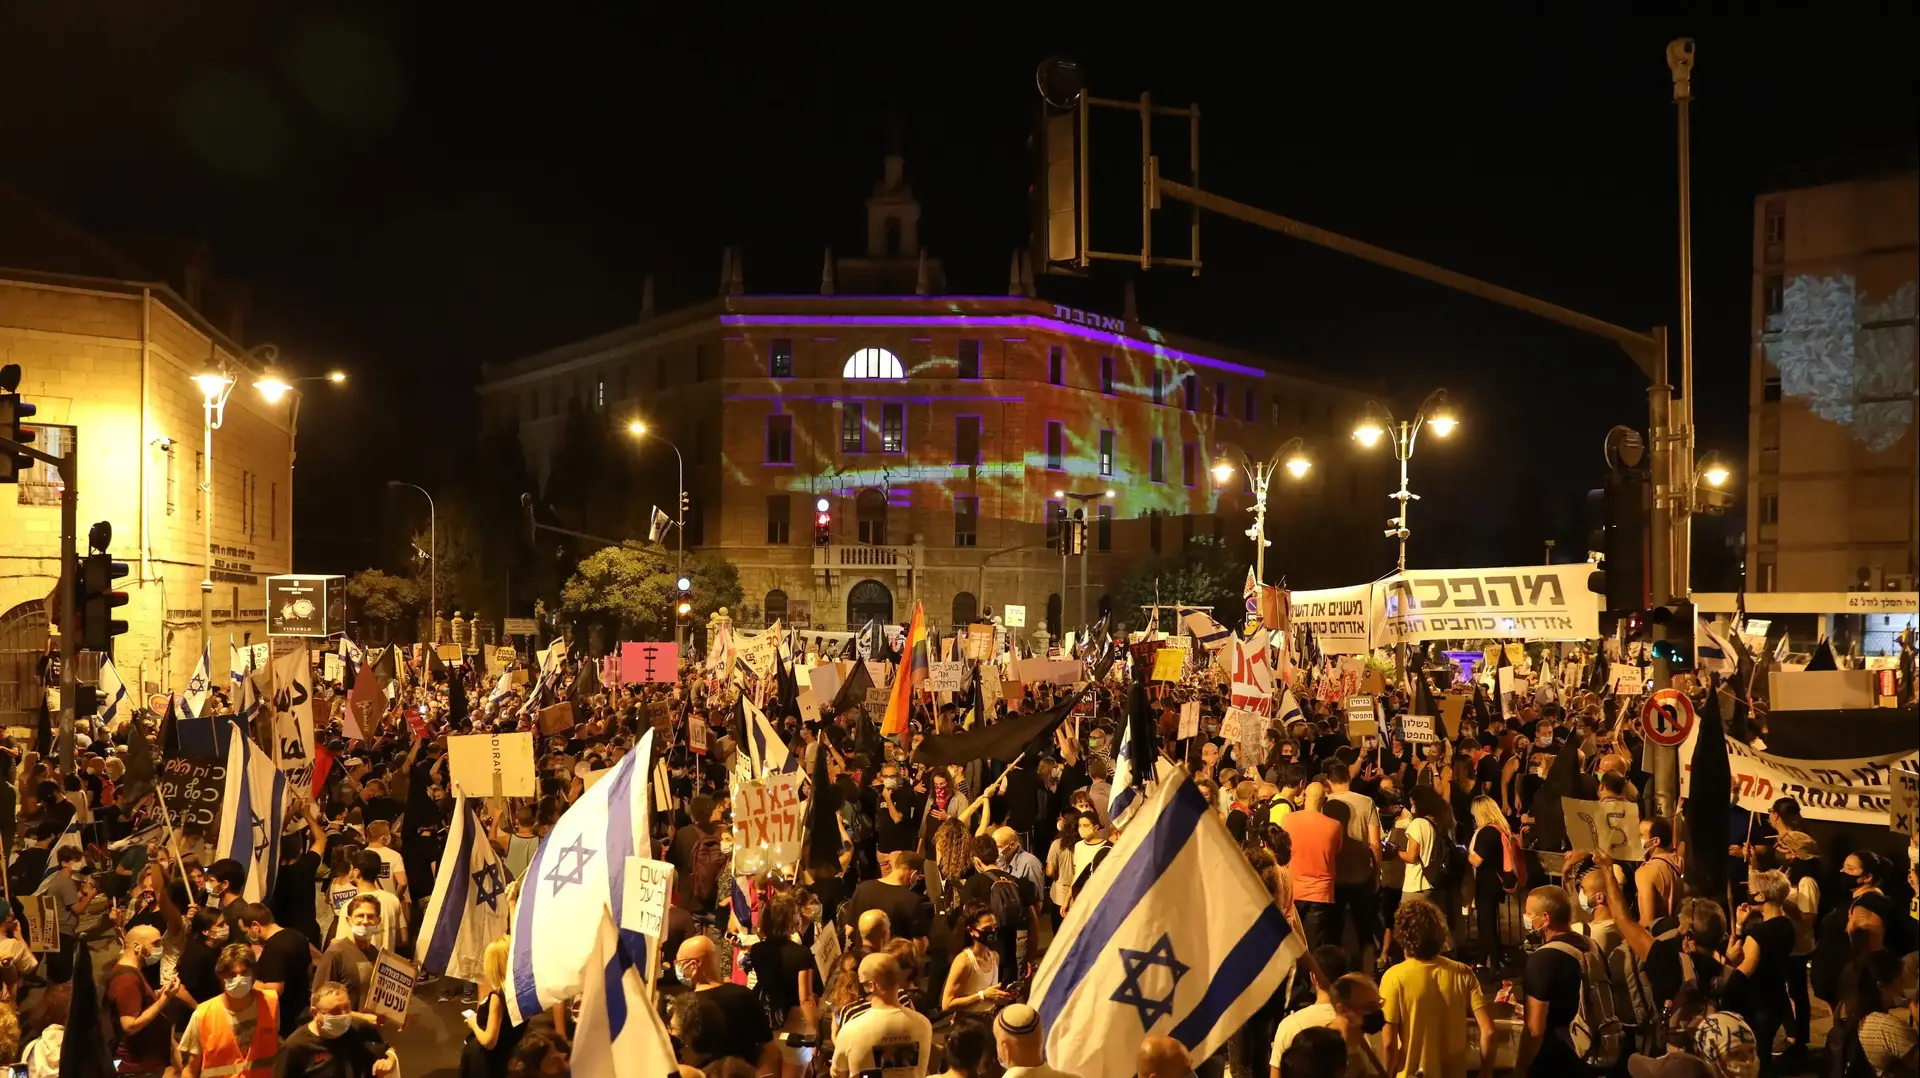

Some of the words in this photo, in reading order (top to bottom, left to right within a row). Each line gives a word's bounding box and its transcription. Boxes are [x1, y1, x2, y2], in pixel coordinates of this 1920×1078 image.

[1054, 304, 1125, 332] ואהבת
[1329, 600, 1363, 616] משנים
[1849, 598, 1858, 606] 62
[1880, 597, 1902, 608] המלך
[1311, 603, 1326, 617] את
[1330, 621, 1365, 634] אזרחים
[1389, 620, 1427, 636] חוקה
[1430, 618, 1496, 631] כותבים
[1350, 698, 1370, 706] בנימין
[1403, 719, 1430, 729] כשלון
[742, 783, 798, 816] באנו
